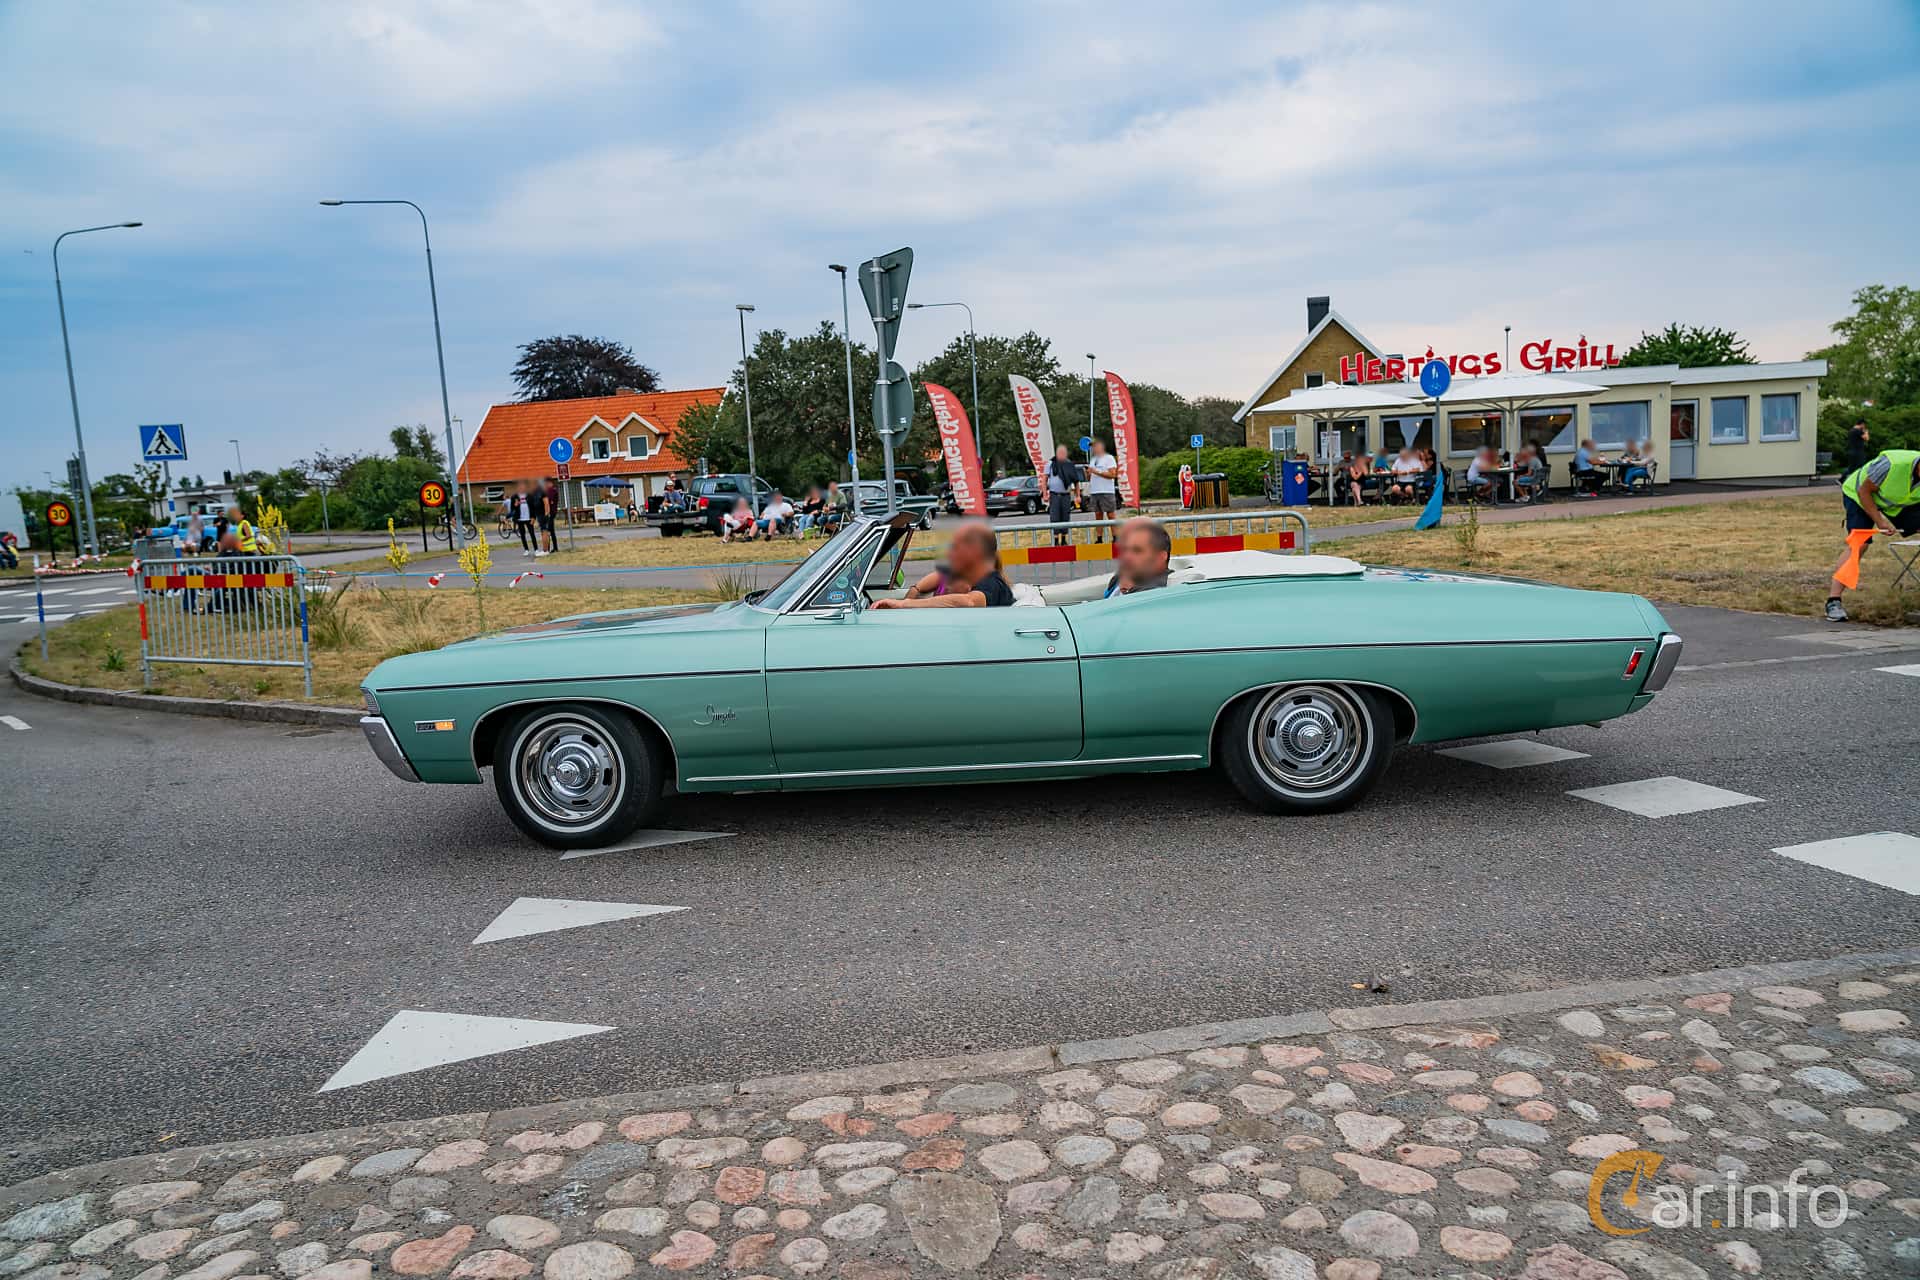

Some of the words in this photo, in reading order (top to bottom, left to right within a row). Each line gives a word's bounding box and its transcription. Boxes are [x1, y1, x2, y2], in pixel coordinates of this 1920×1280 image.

[1520, 335, 1620, 373] GRILL
[425, 489, 440, 500] 30
[51, 509, 66, 520] 30
